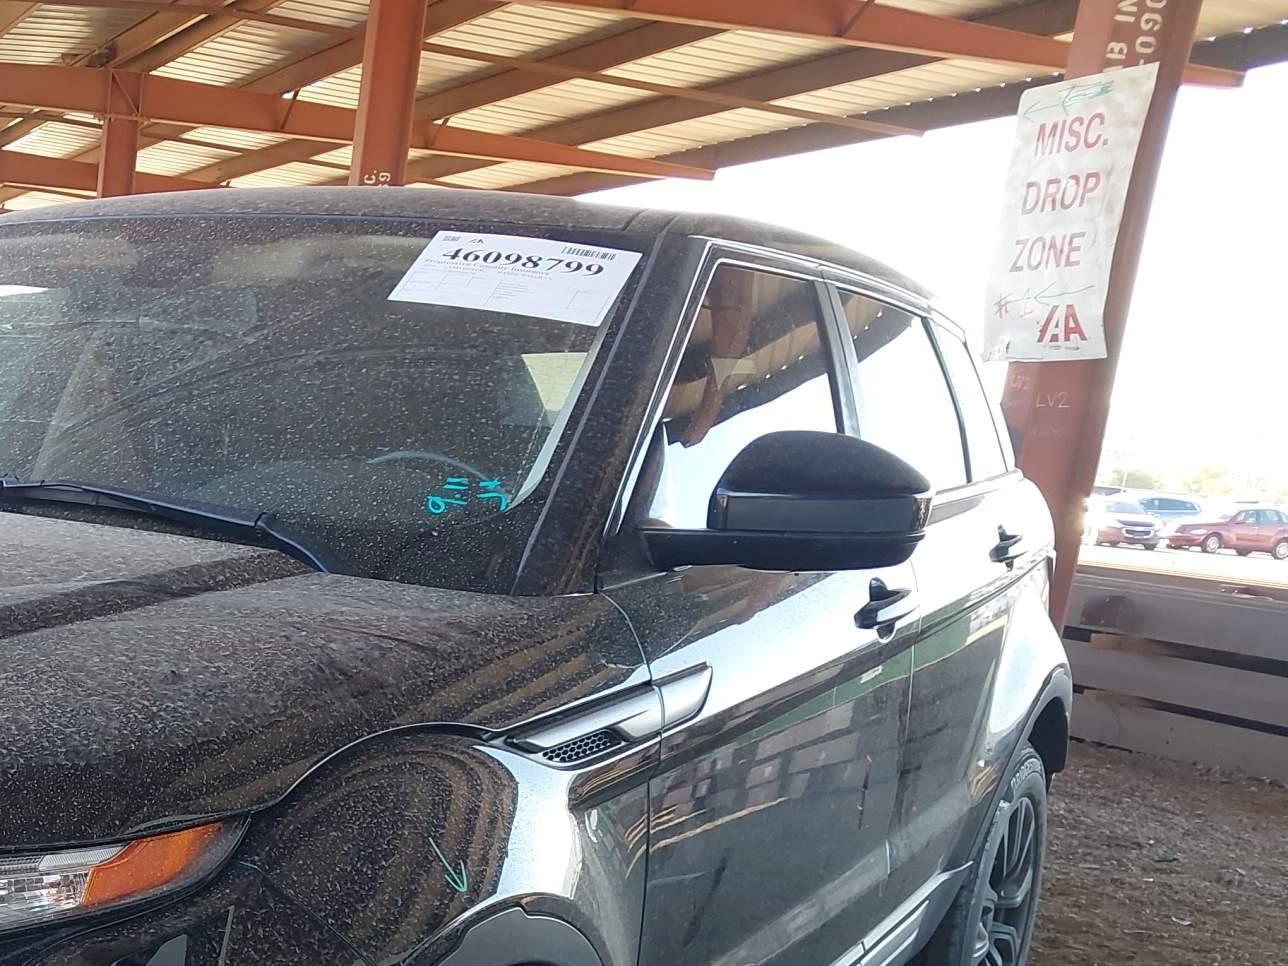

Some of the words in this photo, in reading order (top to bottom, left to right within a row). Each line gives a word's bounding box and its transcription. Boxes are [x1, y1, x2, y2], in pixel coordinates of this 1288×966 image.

[1034, 112, 1109, 157] MISC.
[1021, 171, 1101, 215] DROP
[442, 247, 604, 277] 46098799
[1009, 231, 1086, 272] ZONE
